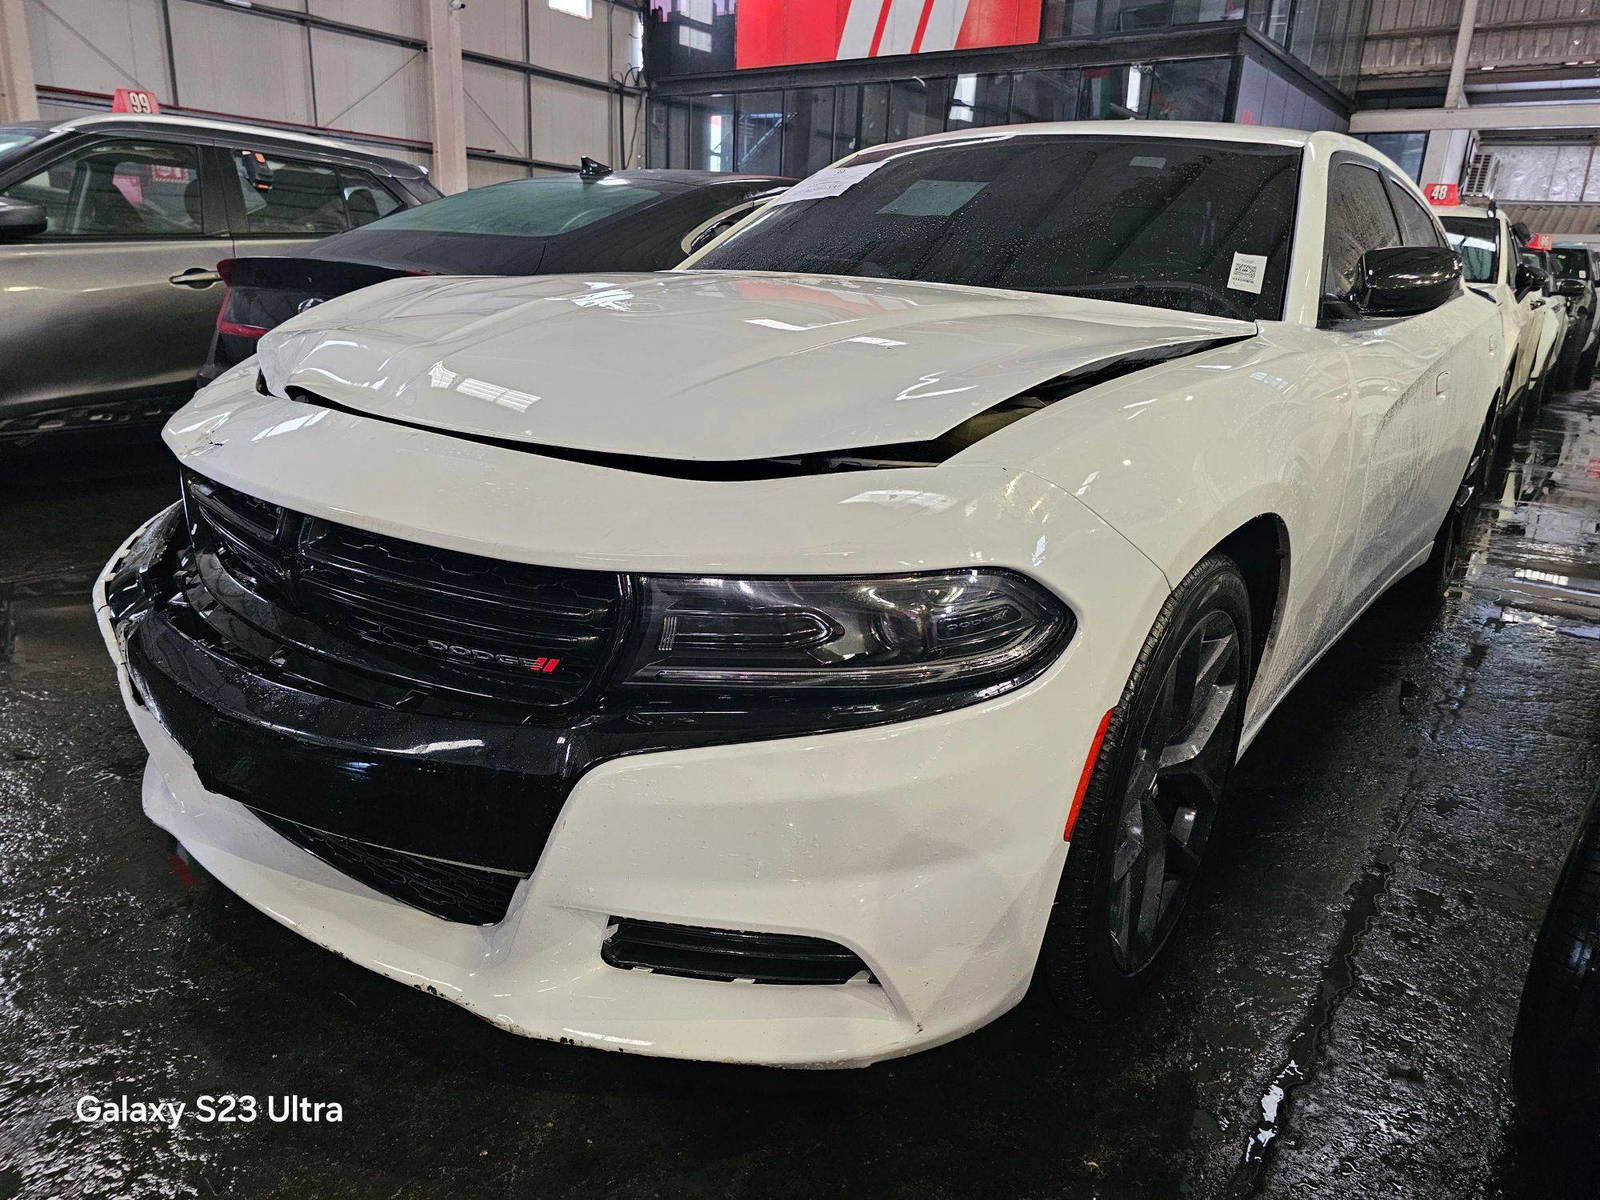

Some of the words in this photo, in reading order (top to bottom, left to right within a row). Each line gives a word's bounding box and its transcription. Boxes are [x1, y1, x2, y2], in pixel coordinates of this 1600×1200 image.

[129, 92, 152, 114] 99
[1431, 184, 1449, 200] 48
[427, 639, 544, 669] DODGE
